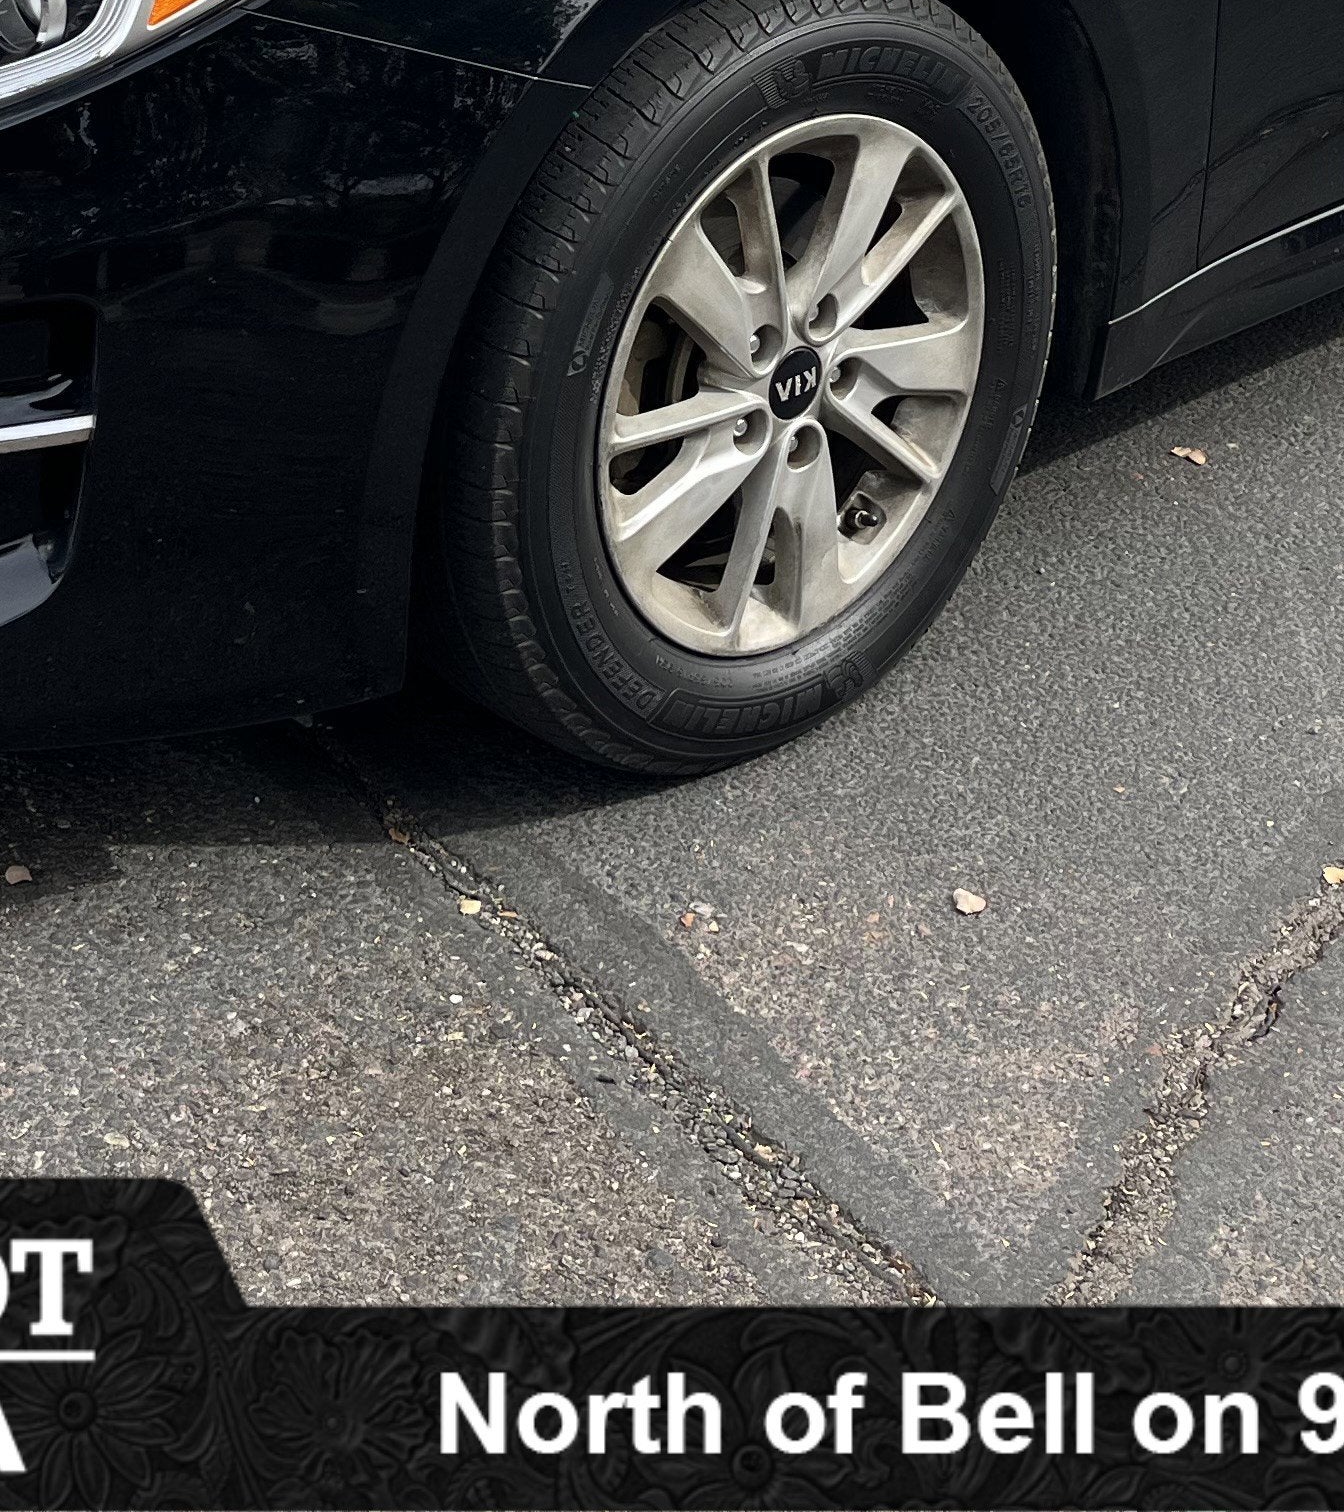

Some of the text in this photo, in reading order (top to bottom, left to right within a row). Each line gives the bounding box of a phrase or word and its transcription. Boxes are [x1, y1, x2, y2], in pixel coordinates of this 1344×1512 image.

[816, 45, 963, 96] MICHELIN
[774, 366, 817, 403] KIA
[569, 600, 655, 711] DEFENDER
[663, 681, 824, 734] MICHELIN
